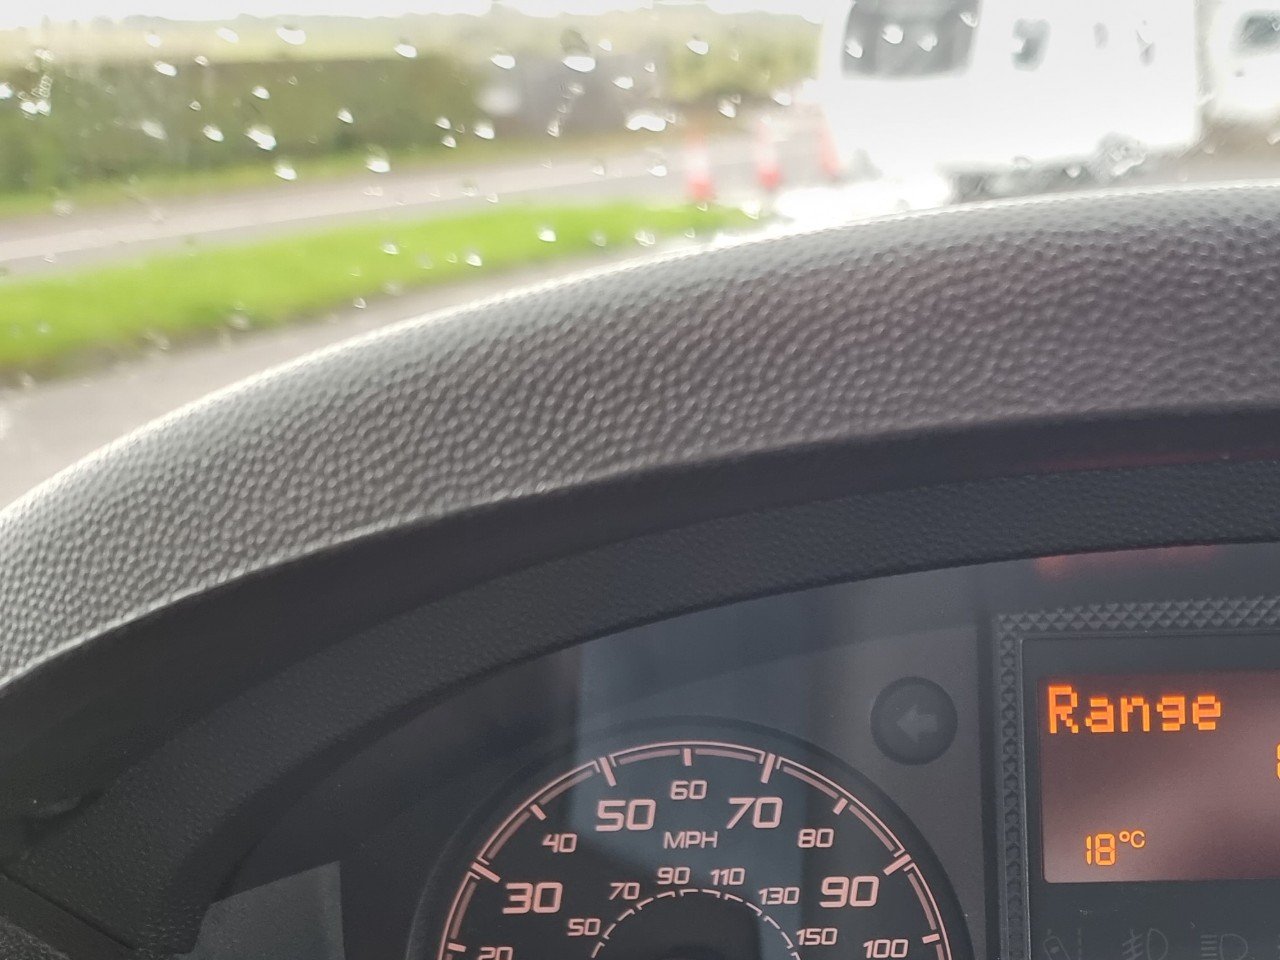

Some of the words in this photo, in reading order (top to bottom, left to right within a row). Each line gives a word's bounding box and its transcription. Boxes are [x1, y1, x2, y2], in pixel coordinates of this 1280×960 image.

[1048, 685, 1221, 734] Range
[670, 780, 707, 799] 60
[596, 799, 656, 831] 50
[726, 797, 782, 829] 70
[542, 833, 577, 853] 40
[663, 831, 718, 849] MPH
[797, 829, 833, 848] 80
[657, 866, 690, 884] 90
[710, 867, 744, 885] 110
[502, 882, 562, 914] 30
[609, 882, 639, 901] 70
[758, 886, 799, 905] 130
[819, 876, 879, 908] 90
[568, 918, 600, 936] 50
[796, 927, 837, 945] 150
[863, 938, 908, 959] 100
